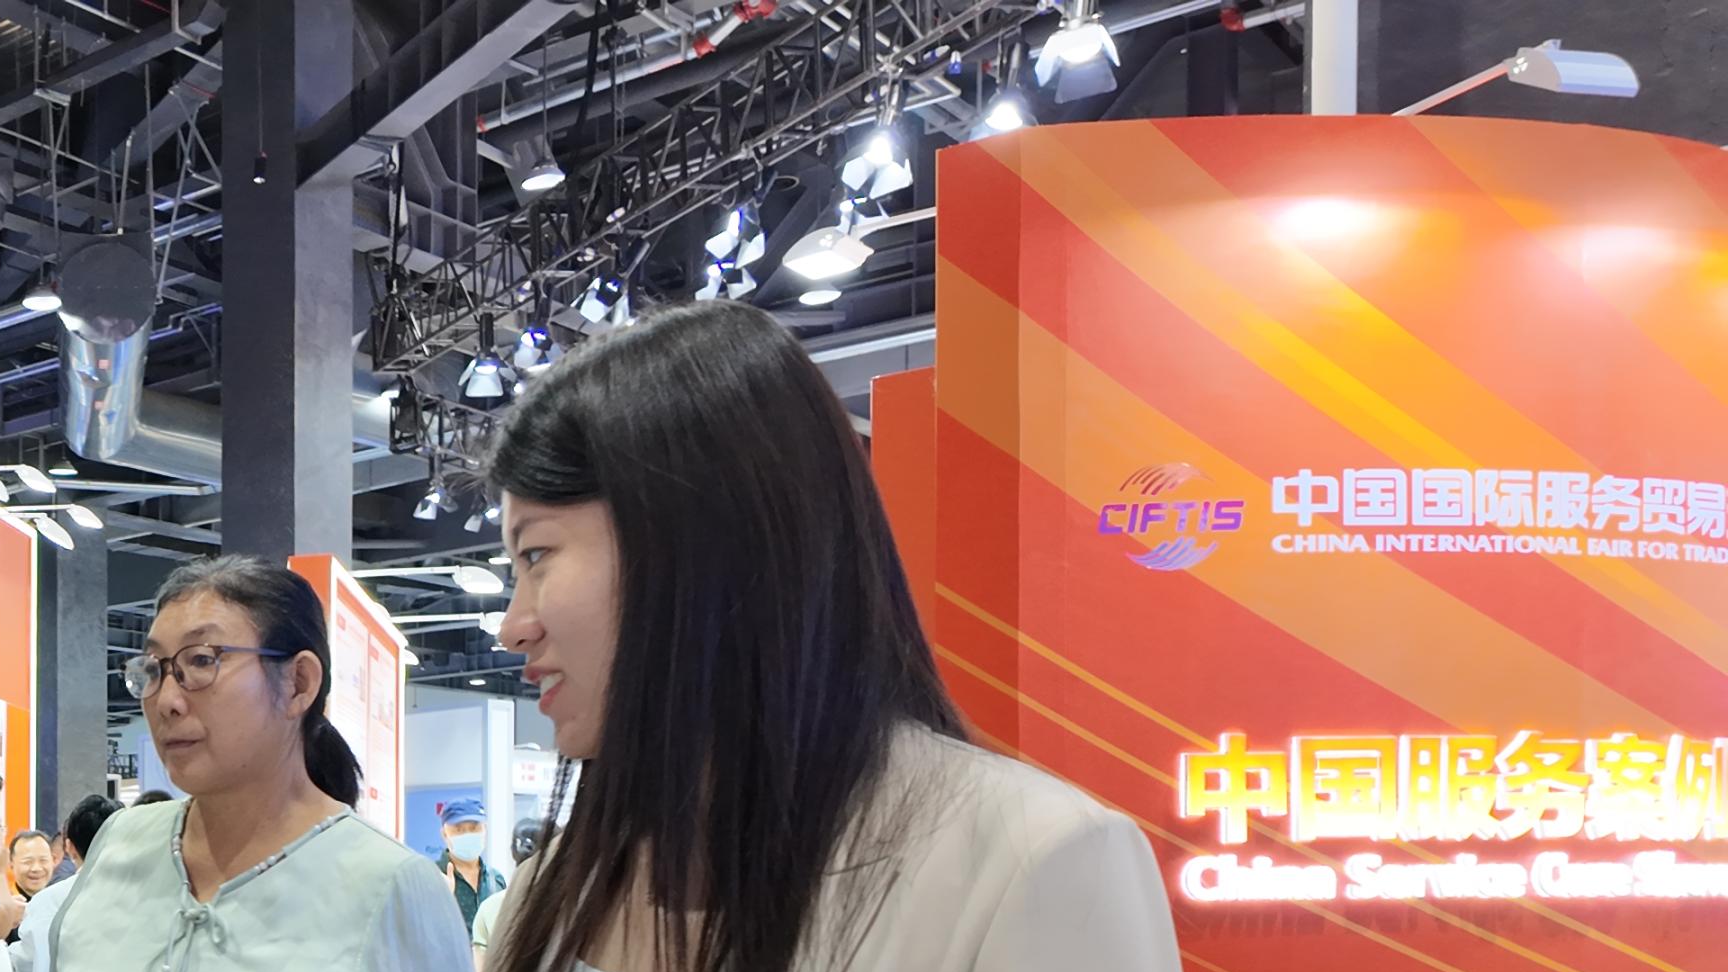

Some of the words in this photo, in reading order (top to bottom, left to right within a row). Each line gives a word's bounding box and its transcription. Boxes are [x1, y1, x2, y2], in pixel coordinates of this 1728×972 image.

[1098, 500, 1245, 535] CIFTIS
[1271, 467, 1726, 539] 中国国际服务贸易
[1272, 533, 1370, 554] CHINA
[1374, 533, 1583, 556] INTERNATIONAL
[1586, 536, 1635, 558] FAIR
[1637, 540, 1679, 561] FOR
[1181, 853, 1338, 901] China
[1344, 852, 1528, 899] Service
